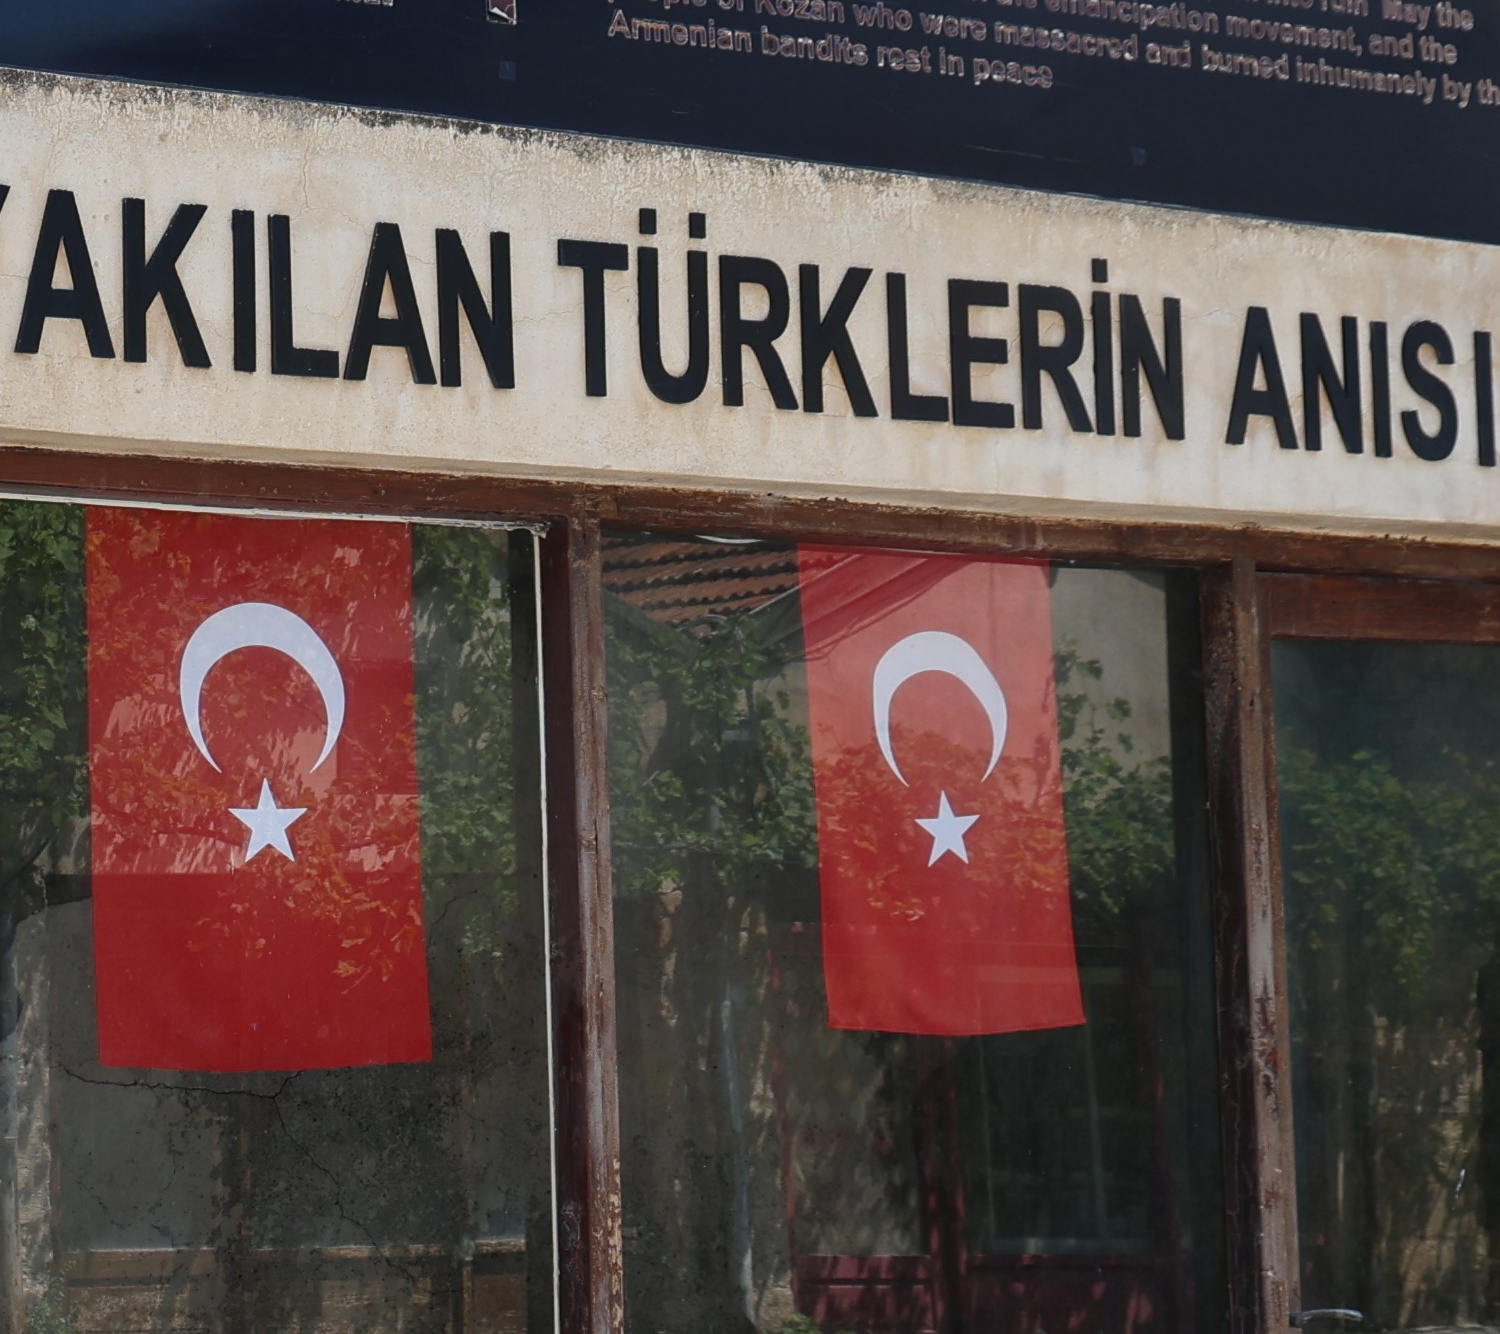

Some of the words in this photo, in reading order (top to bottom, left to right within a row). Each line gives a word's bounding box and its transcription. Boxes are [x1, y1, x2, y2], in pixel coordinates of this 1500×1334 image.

[607, 8, 752, 53] Armenian
[760, 24, 869, 66] bandits
[876, 45, 932, 73] rest
[938, 46, 965, 77] in
[972, 56, 1053, 88] peace
[1225, 14, 1362, 57] movement,
[1368, 31, 1414, 59] and
[1417, 34, 1457, 65] the
[1434, 0, 1474, 31] the
[557, 208, 1185, 441] TÜRKLERİN
